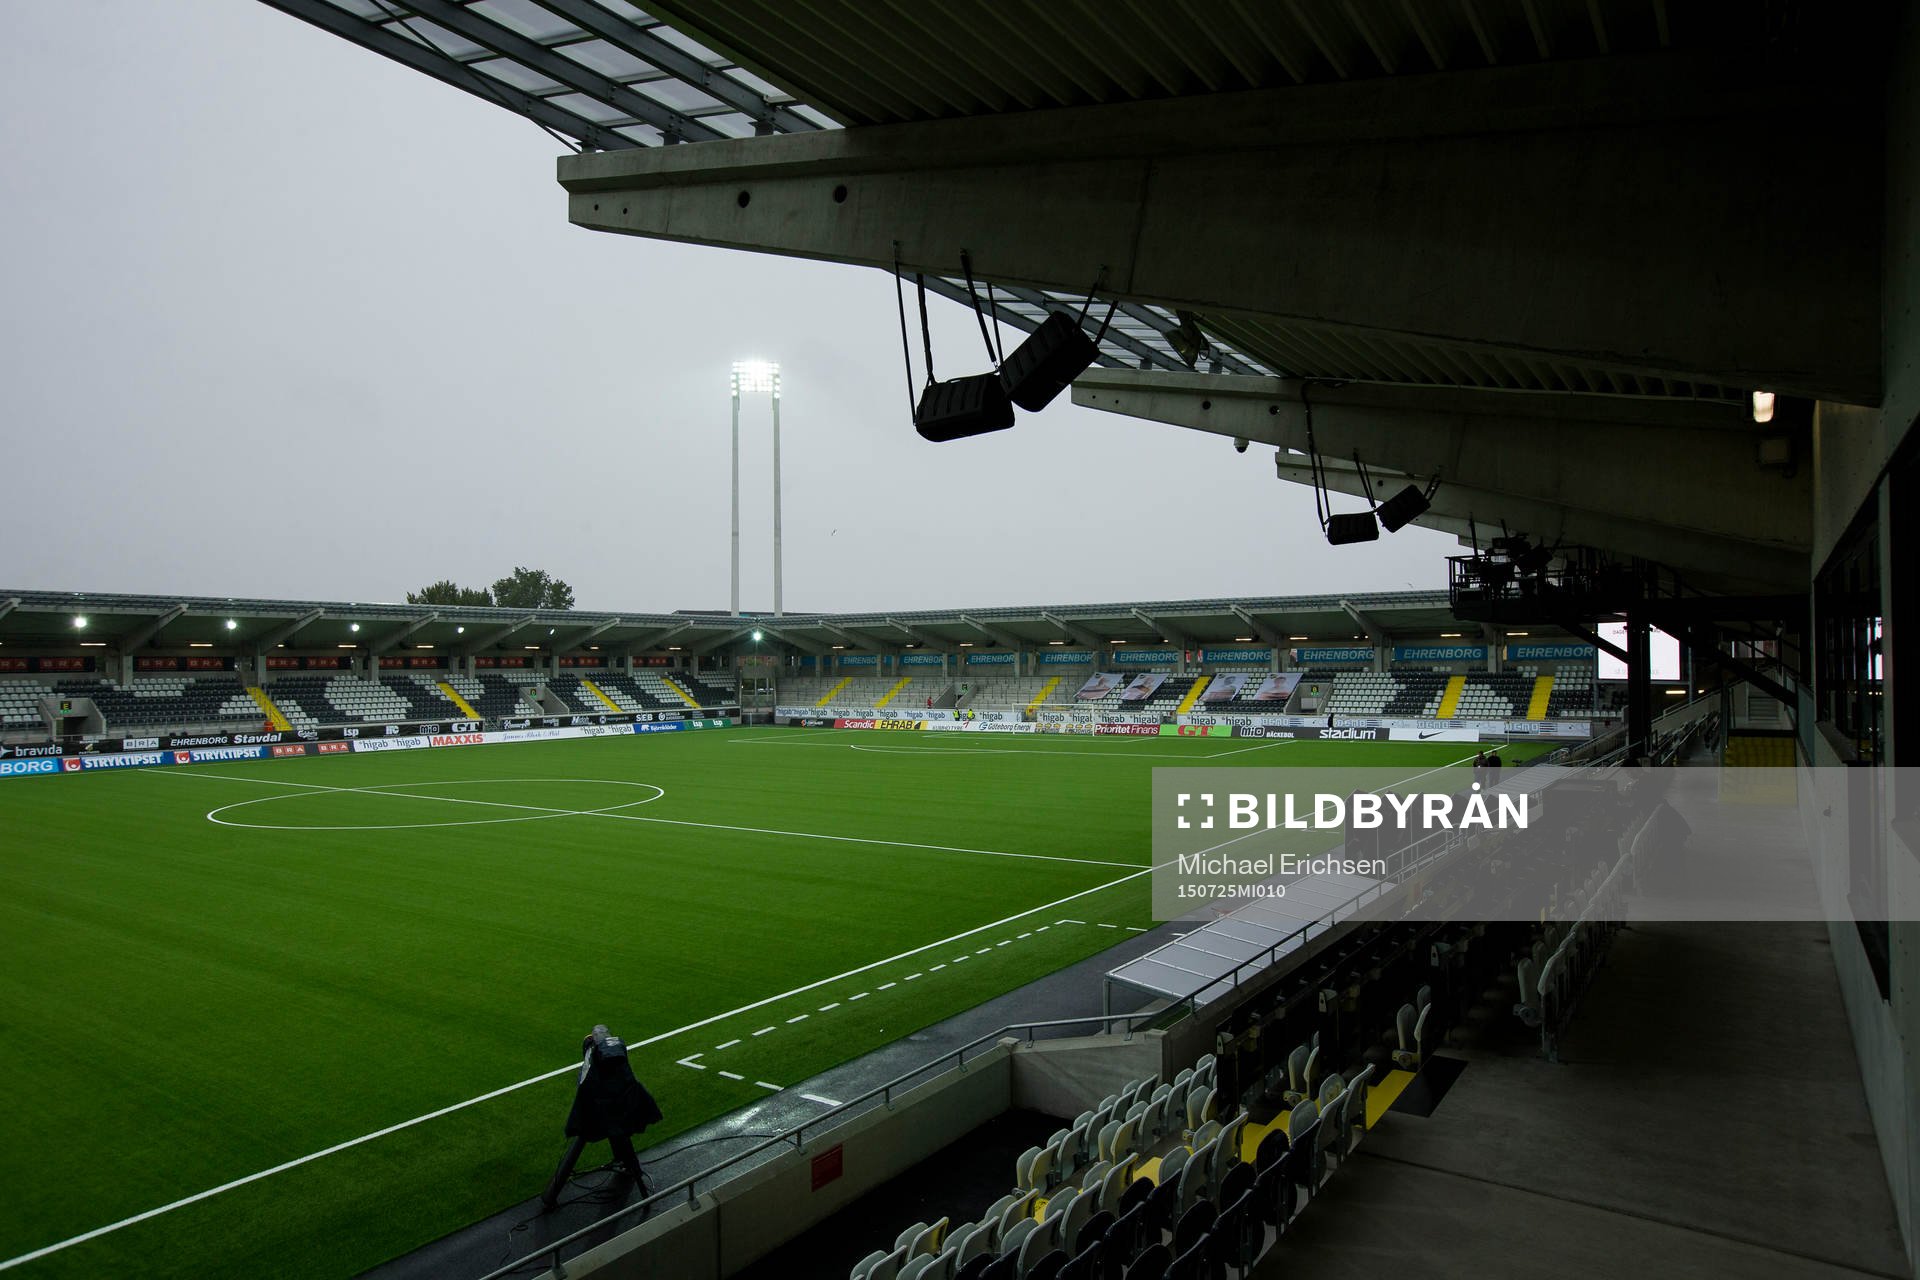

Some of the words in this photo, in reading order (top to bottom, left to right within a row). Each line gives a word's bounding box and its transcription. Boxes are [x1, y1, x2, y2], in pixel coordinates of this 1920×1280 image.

[1206, 651, 1271, 661] EHRENBORG
[1303, 650, 1375, 660] EHRENBORG
[1403, 648, 1482, 659] EHRENBORG
[1516, 646, 1593, 658] EHRENBOR
[971, 654, 1014, 663] EHRENBOR
[635, 713, 653, 722] SEB
[843, 719, 874, 729] Scandic
[880, 720, 913, 729] EHRAB
[1095, 725, 1130, 735] Prioritet
[1131, 726, 1159, 735] Finans
[1177, 725, 1213, 736] GT
[1319, 727, 1377, 740] stadium
[125, 739, 158, 748] BRA
[171, 736, 228, 747] EHRENBORG
[233, 733, 282, 744] Stavdal
[432, 734, 484, 746] MAXXIS
[15, 744, 63, 757] bravida
[275, 746, 304, 755] BRA
[320, 743, 348, 752] BRA
[192, 746, 262, 762] STRYKTIPSET
[83, 753, 162, 769] STRYKTIPSET
[0, 760, 54, 774] BORG
